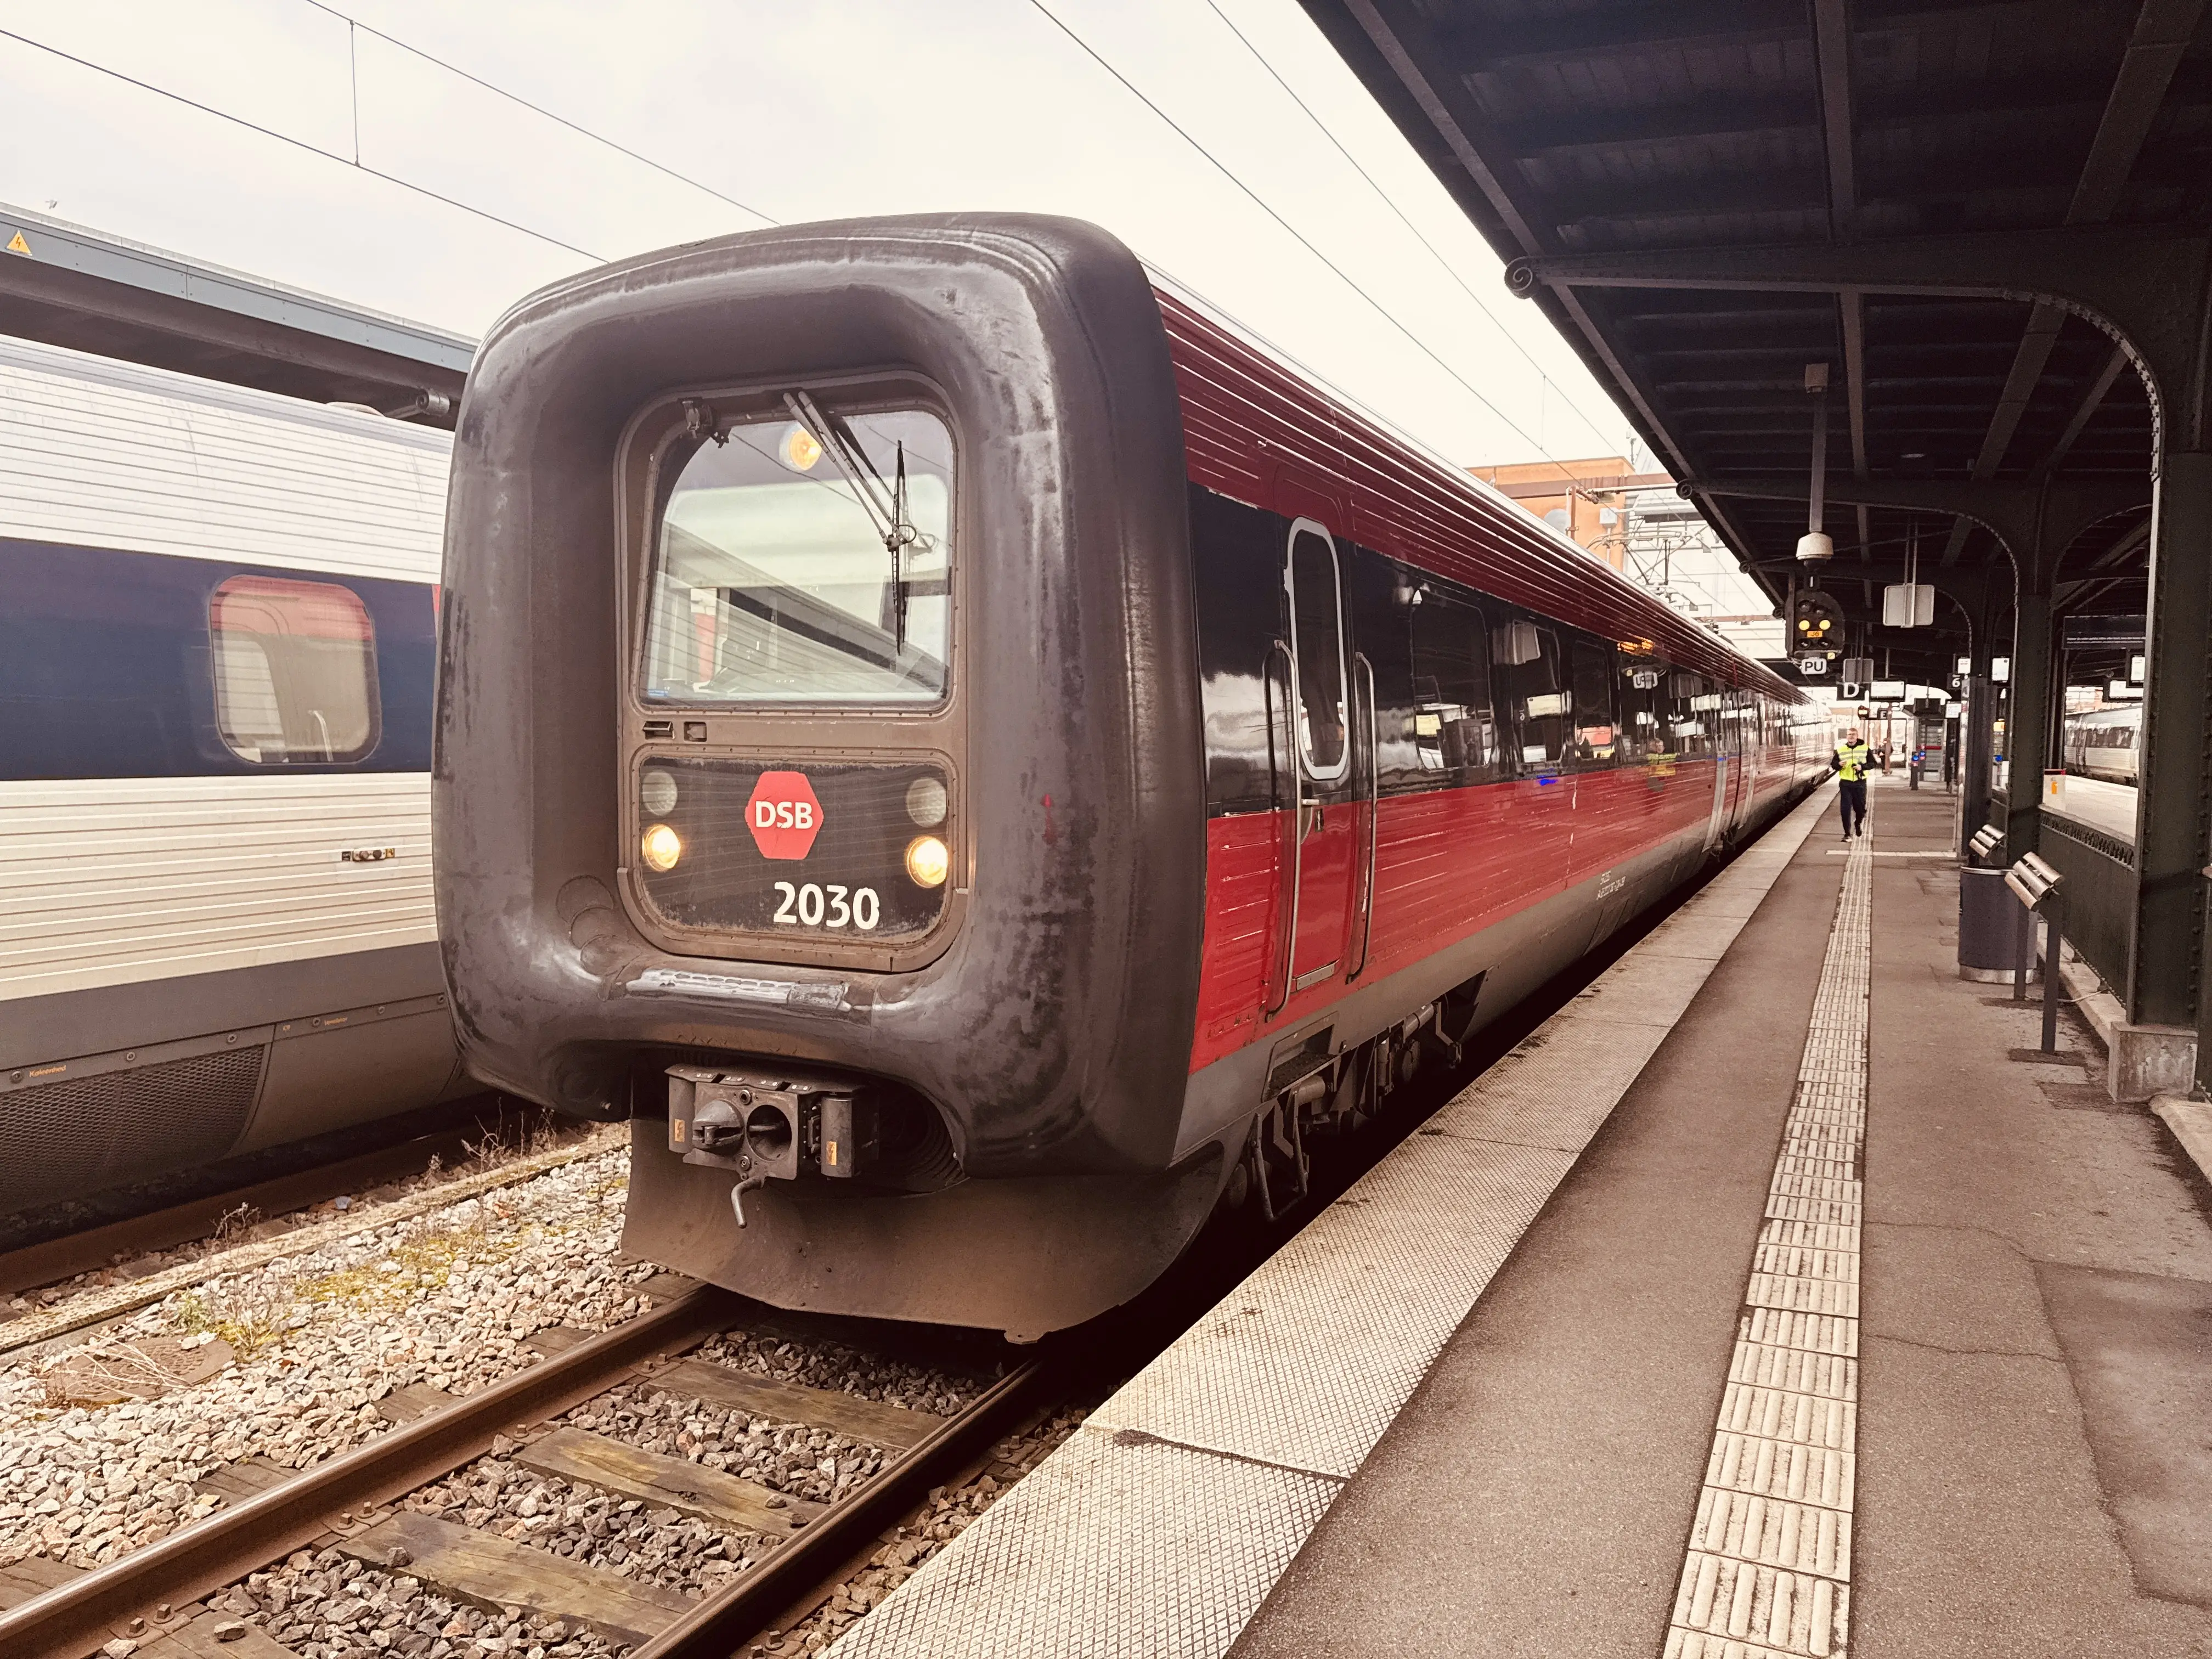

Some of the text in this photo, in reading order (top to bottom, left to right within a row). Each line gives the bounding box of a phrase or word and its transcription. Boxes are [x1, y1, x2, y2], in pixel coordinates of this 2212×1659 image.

[1804, 661, 1824, 672] PU
[1843, 682, 1859, 698] D
[1952, 678, 1961, 688] 6
[755, 800, 813, 830] DSB
[773, 881, 879, 930] 2030
